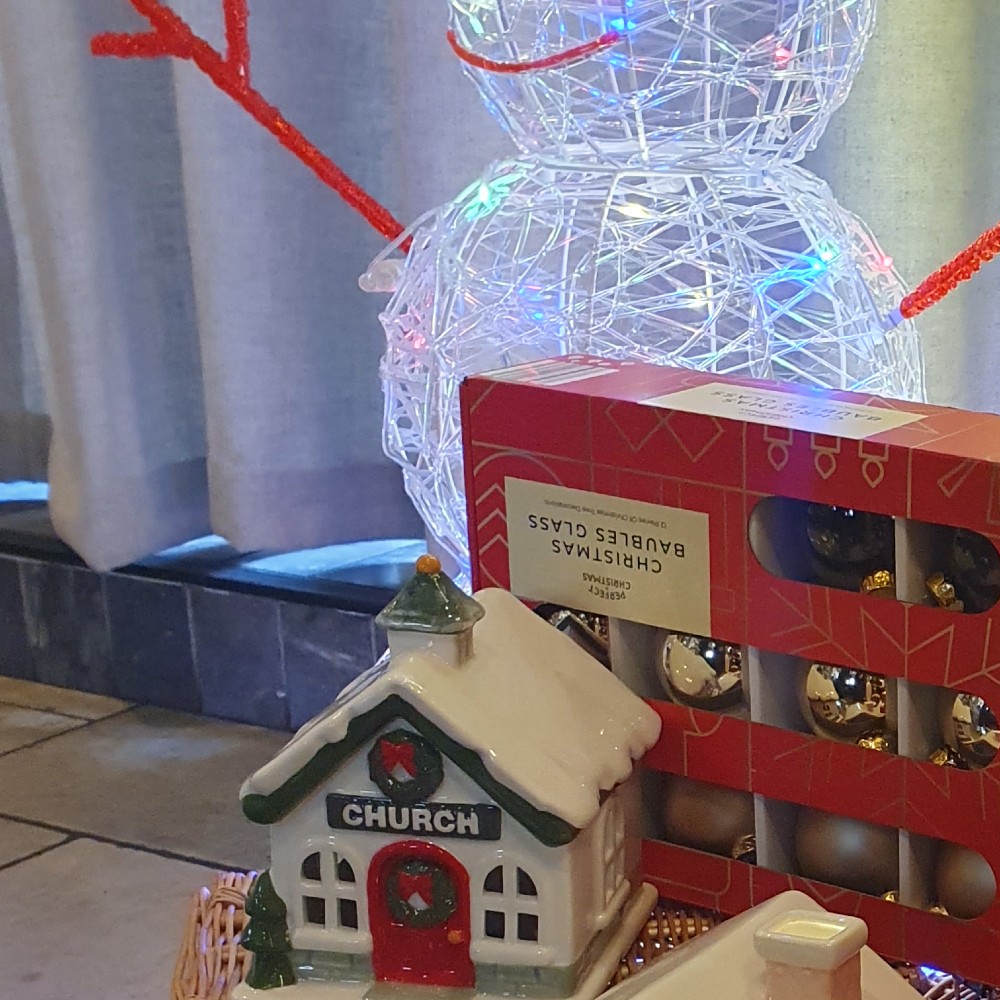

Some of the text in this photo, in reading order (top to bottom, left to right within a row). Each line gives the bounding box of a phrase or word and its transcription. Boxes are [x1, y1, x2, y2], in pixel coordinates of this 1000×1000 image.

[528, 514, 685, 558] BAUBLES GLASS
[552, 539, 662, 574] CHRISTMAS
[582, 572, 631, 590] CHRISTMAS
[588, 585, 626, 600] PERFECT
[342, 803, 479, 835] CHURCH
